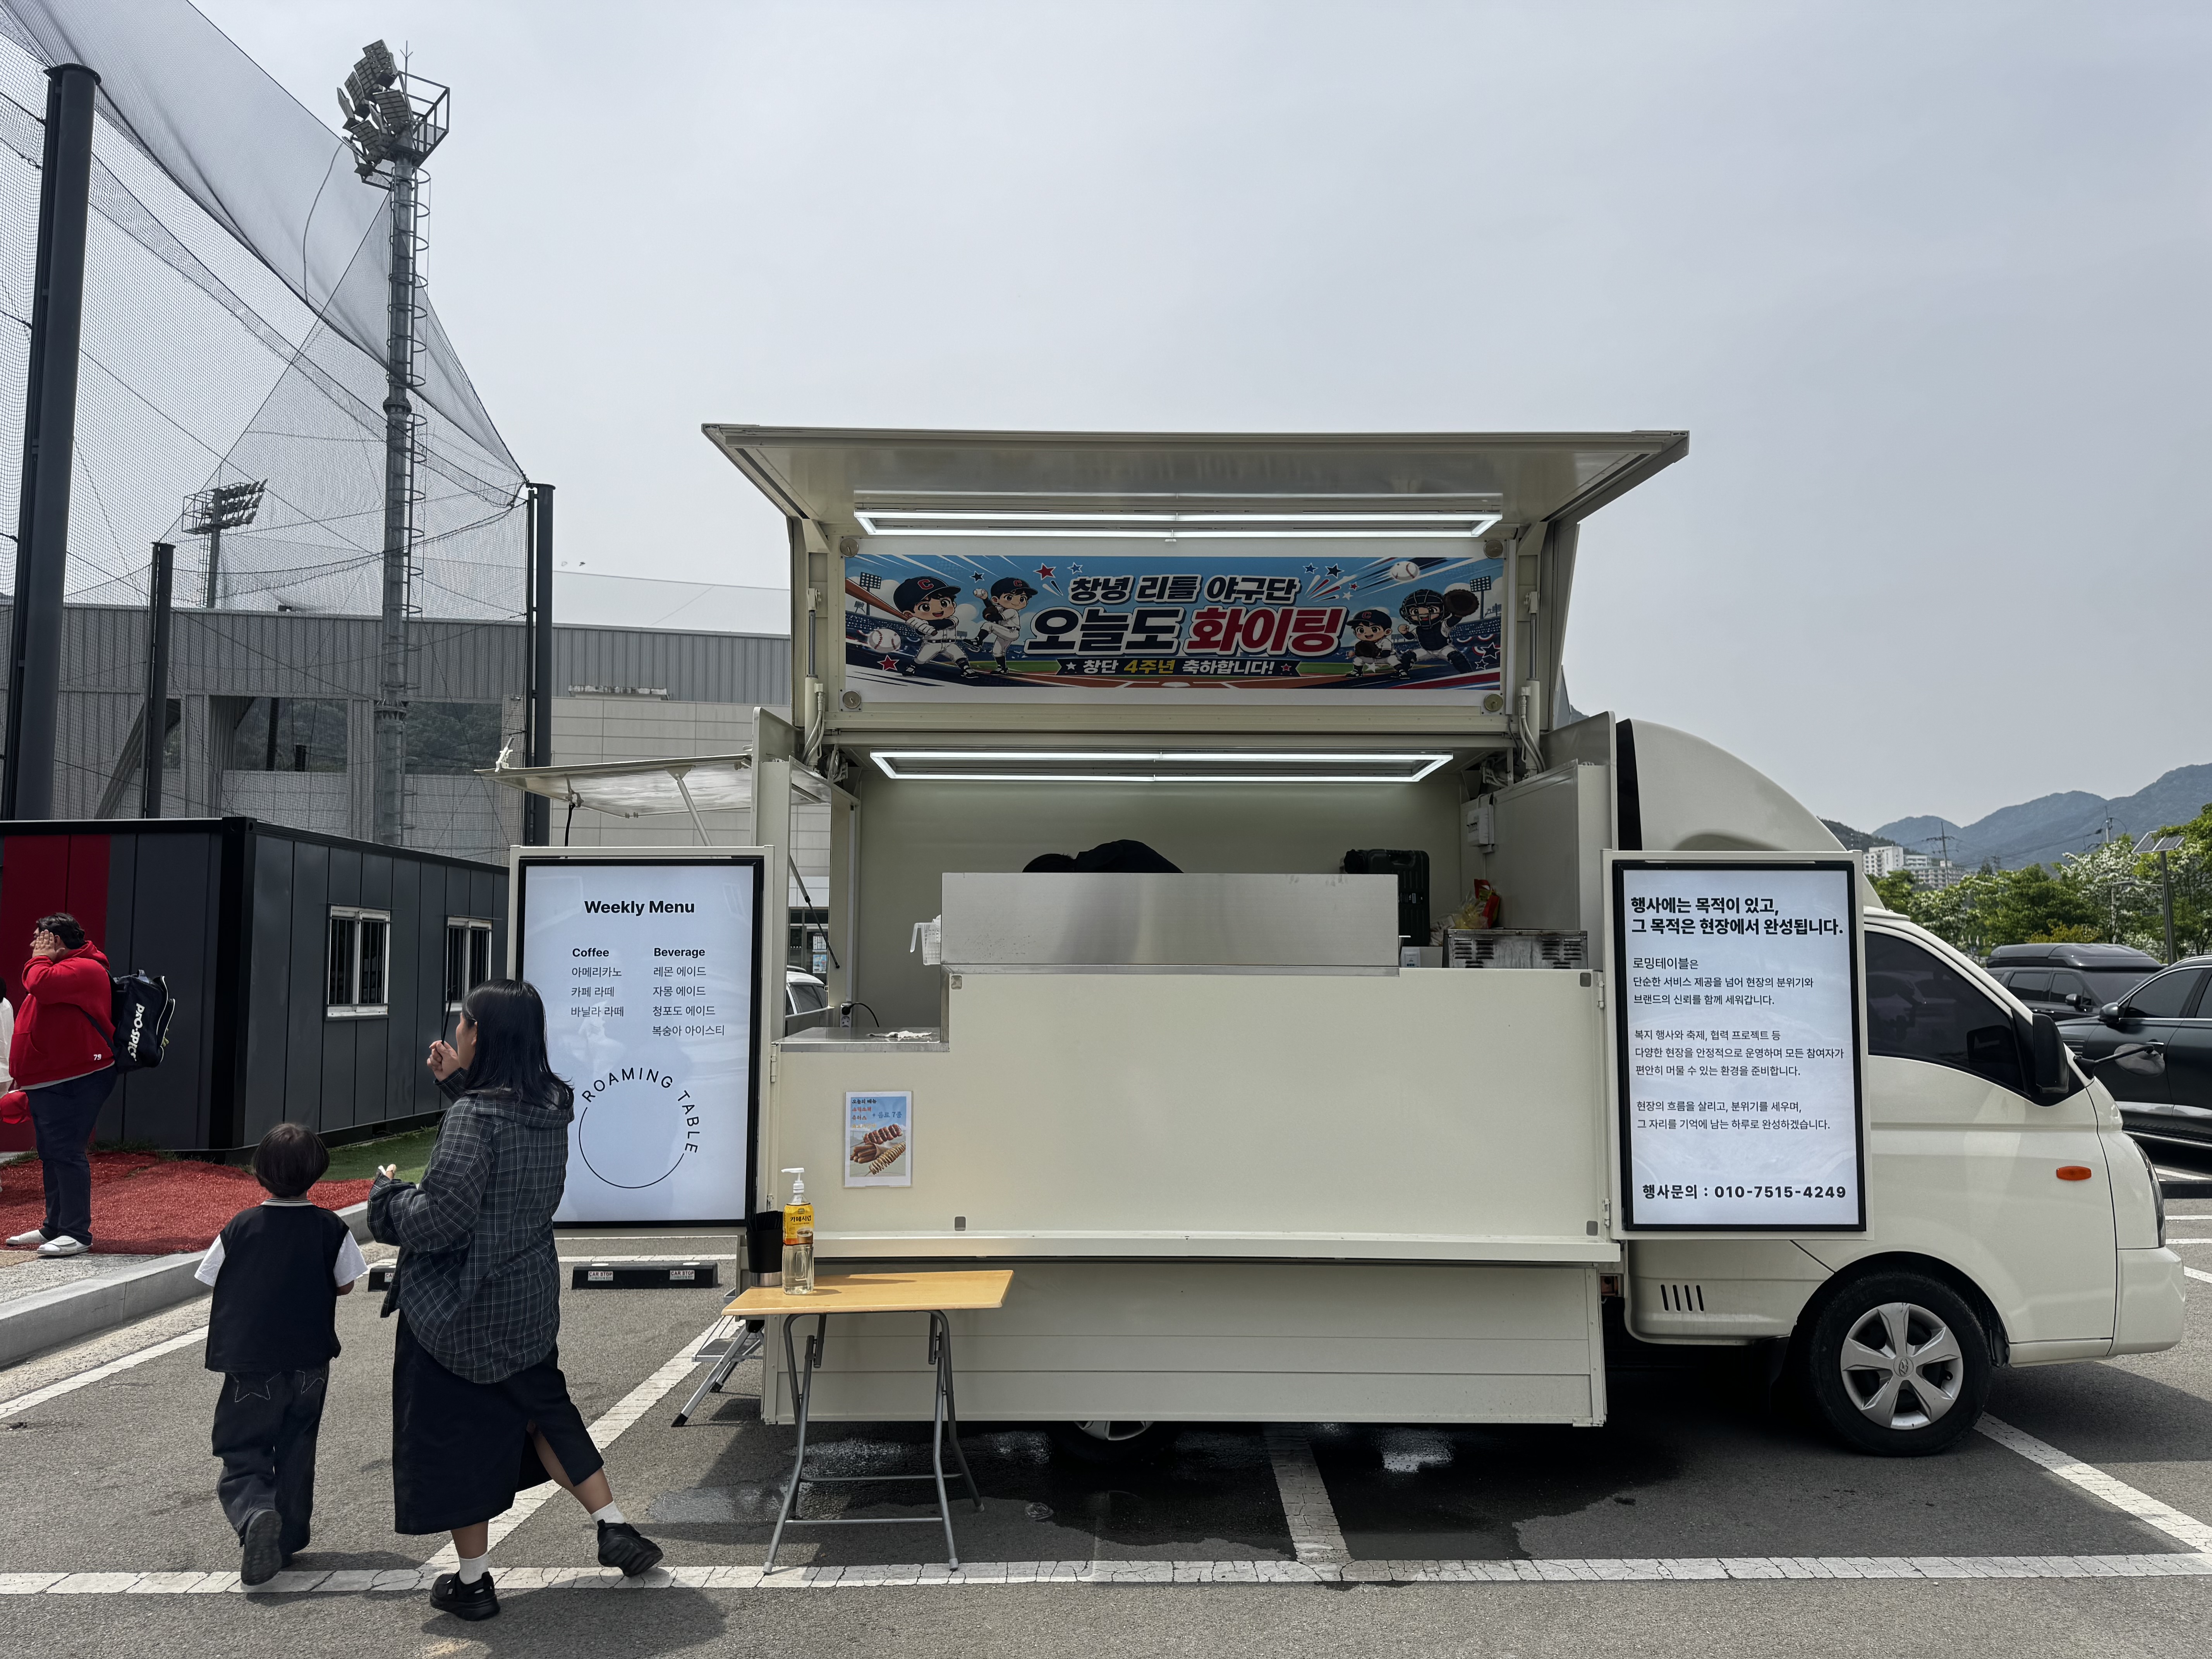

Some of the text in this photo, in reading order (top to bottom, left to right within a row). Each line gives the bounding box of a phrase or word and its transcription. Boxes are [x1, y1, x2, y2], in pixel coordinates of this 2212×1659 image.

[917, 579, 934, 590] C
[1072, 575, 1297, 603] 창녕 리틀 야구단
[1028, 608, 1344, 654] 오늘도 화이팅
[1083, 660, 1274, 675] 창단 4주년 축하합니다!
[584, 901, 694, 916] Weekly Menu
[1631, 897, 1778, 916] 행사에는 목적이 있고,
[1632, 918, 1843, 935] 그 목적은 현장에서 완성됩니다.
[573, 948, 609, 957] Coffee
[654, 948, 705, 958] Beverage
[1633, 957, 1698, 969] 로밍테이블은
[572, 967, 622, 977] 아메리카노
[654, 966, 706, 977] 레몬 에이드
[1633, 977, 1814, 988] 단순한 서비스 제공을 넘어 현장의 분위기와
[572, 987, 614, 997] 카페 라떼
[653, 986, 706, 996] 자몽 에이드
[1634, 994, 1774, 1005] 브랜드의 신뢰를 함께 세워갑니다.
[571, 1006, 623, 1017] 바닐라 라떼
[653, 1006, 715, 1016] 청포도 에이드
[652, 1025, 724, 1036] 복숭아 아이스티
[1635, 1030, 1781, 1041] 복지 행사와 축제, 협력 프로젝트 등
[1635, 1048, 1844, 1058] 다양한 현장을 안정적으로 운영하며 모든 참여자가
[1636, 1065, 1800, 1076] 편안히 머물 수 있는 환경을 준비합니다.
[582, 1068, 700, 1153] ROAMING TABLE
[1637, 1101, 1801, 1113] 현장의 흐름을 살리고, 분위기를 세우며,
[1649, 1119, 1676, 1129] 자리를
[1680, 1119, 1707, 1129] 기억에
[1711, 1119, 1728, 1129] 남는
[1732, 1119, 1759, 1129] 하루로
[1762, 1120, 1830, 1130] 완성하겠습니다.
[1643, 1185, 1845, 1199] 행사문의 : 010-7515-4249
